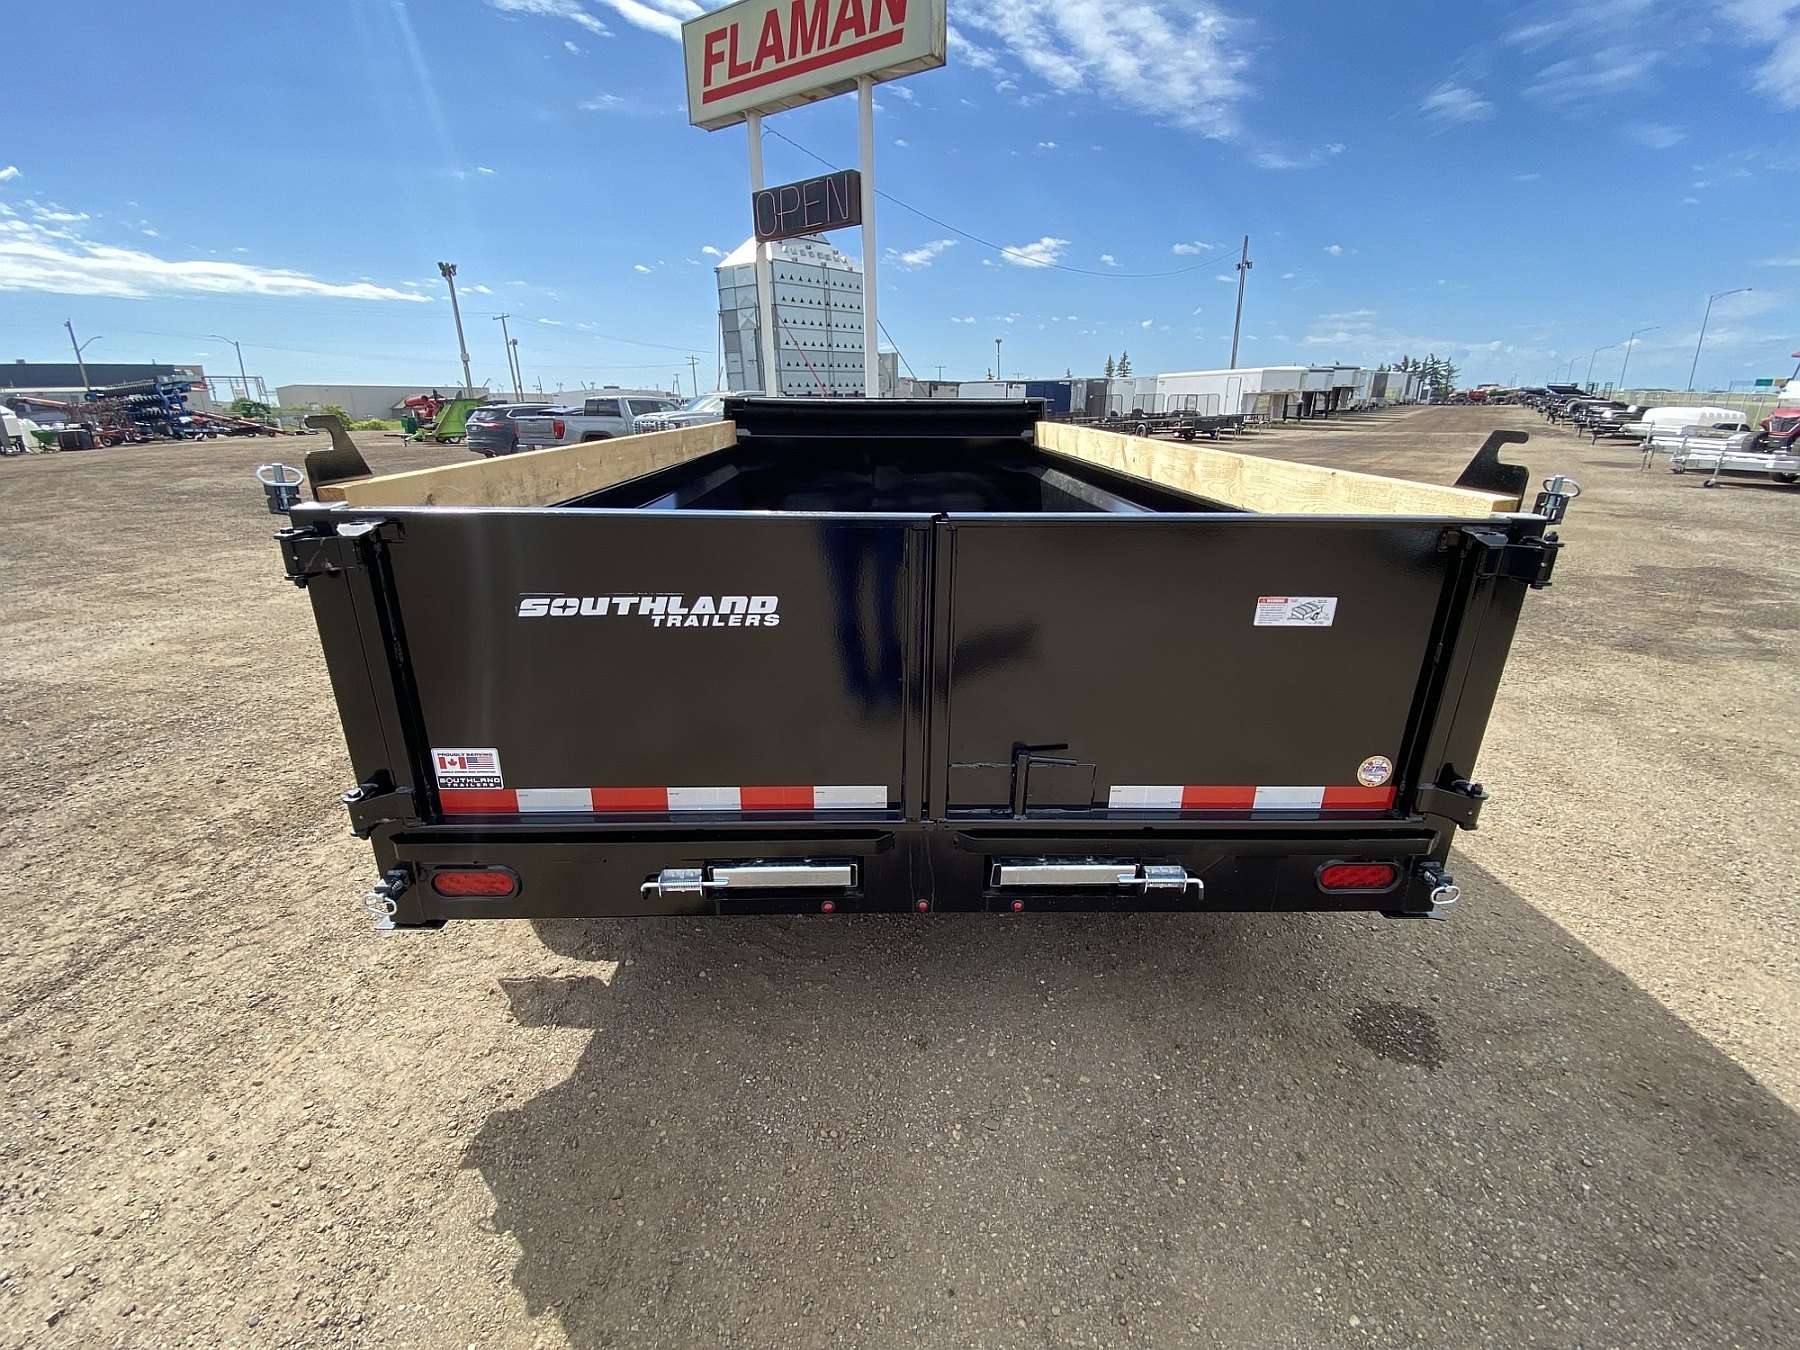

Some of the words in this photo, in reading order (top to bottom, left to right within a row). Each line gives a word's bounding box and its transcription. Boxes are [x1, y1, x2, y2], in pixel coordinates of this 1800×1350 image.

[703, 0, 907, 88] FLAMAN
[756, 171, 849, 237] OPEN
[518, 596, 779, 617] SOUTHLAND
[651, 614, 780, 627] TRAILERS
